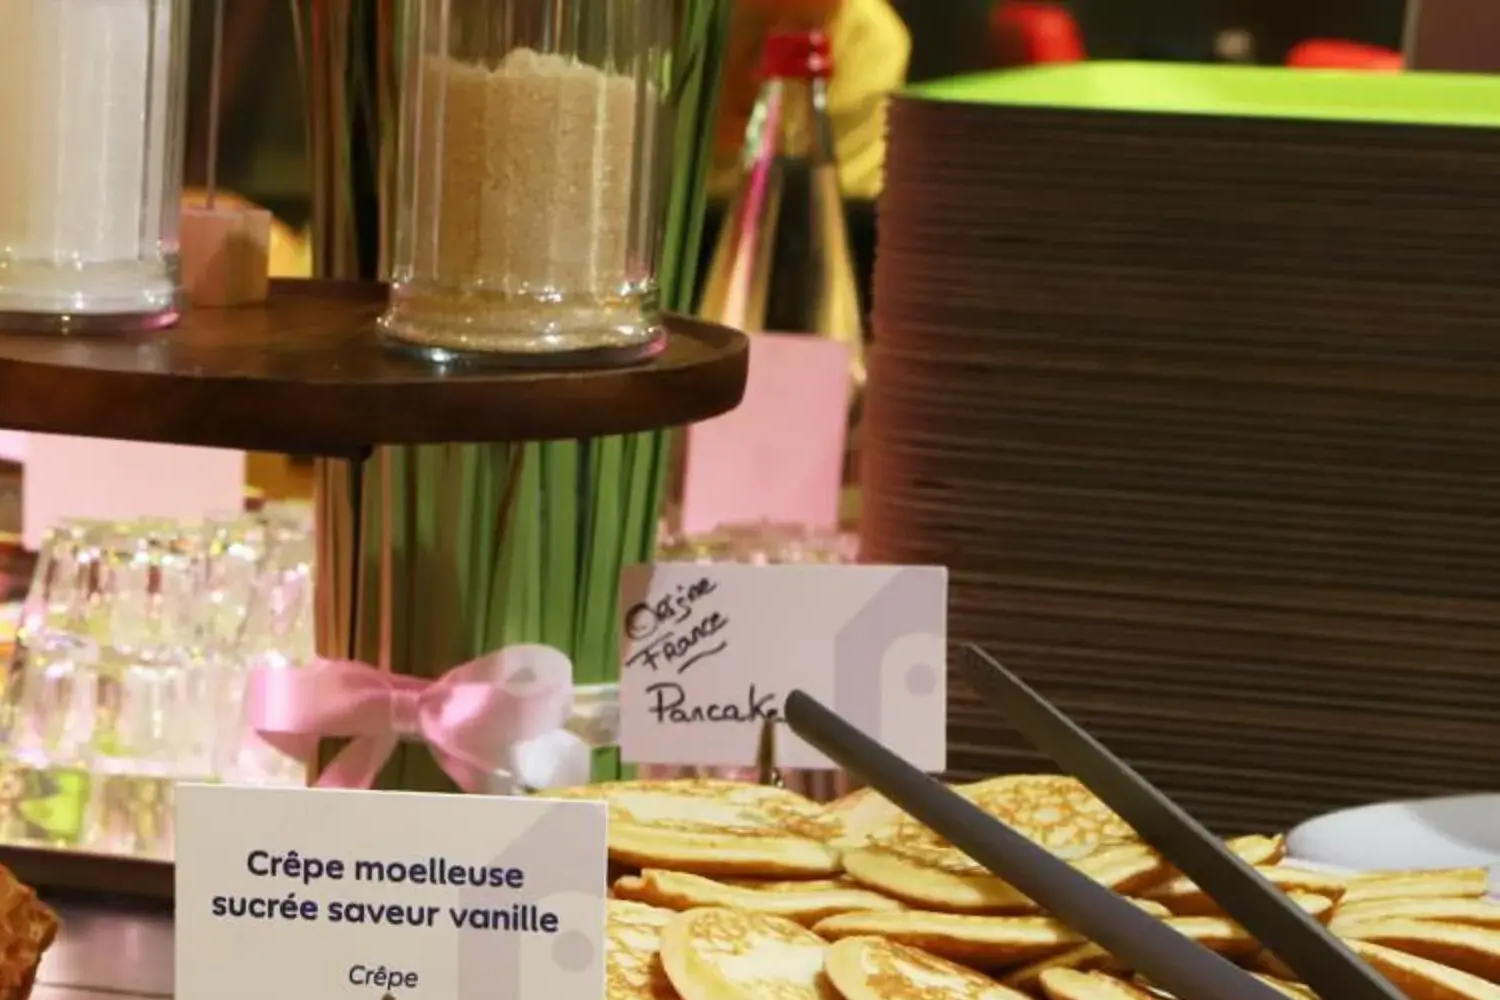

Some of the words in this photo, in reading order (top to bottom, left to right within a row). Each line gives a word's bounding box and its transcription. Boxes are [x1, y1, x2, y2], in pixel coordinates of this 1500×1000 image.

[247, 850, 346, 886] Crêpe
[355, 858, 526, 889] moelleuse
[212, 893, 319, 922] sucrée
[328, 900, 440, 928] saveur
[450, 904, 560, 934] vanille
[348, 964, 420, 991] Crêpe
